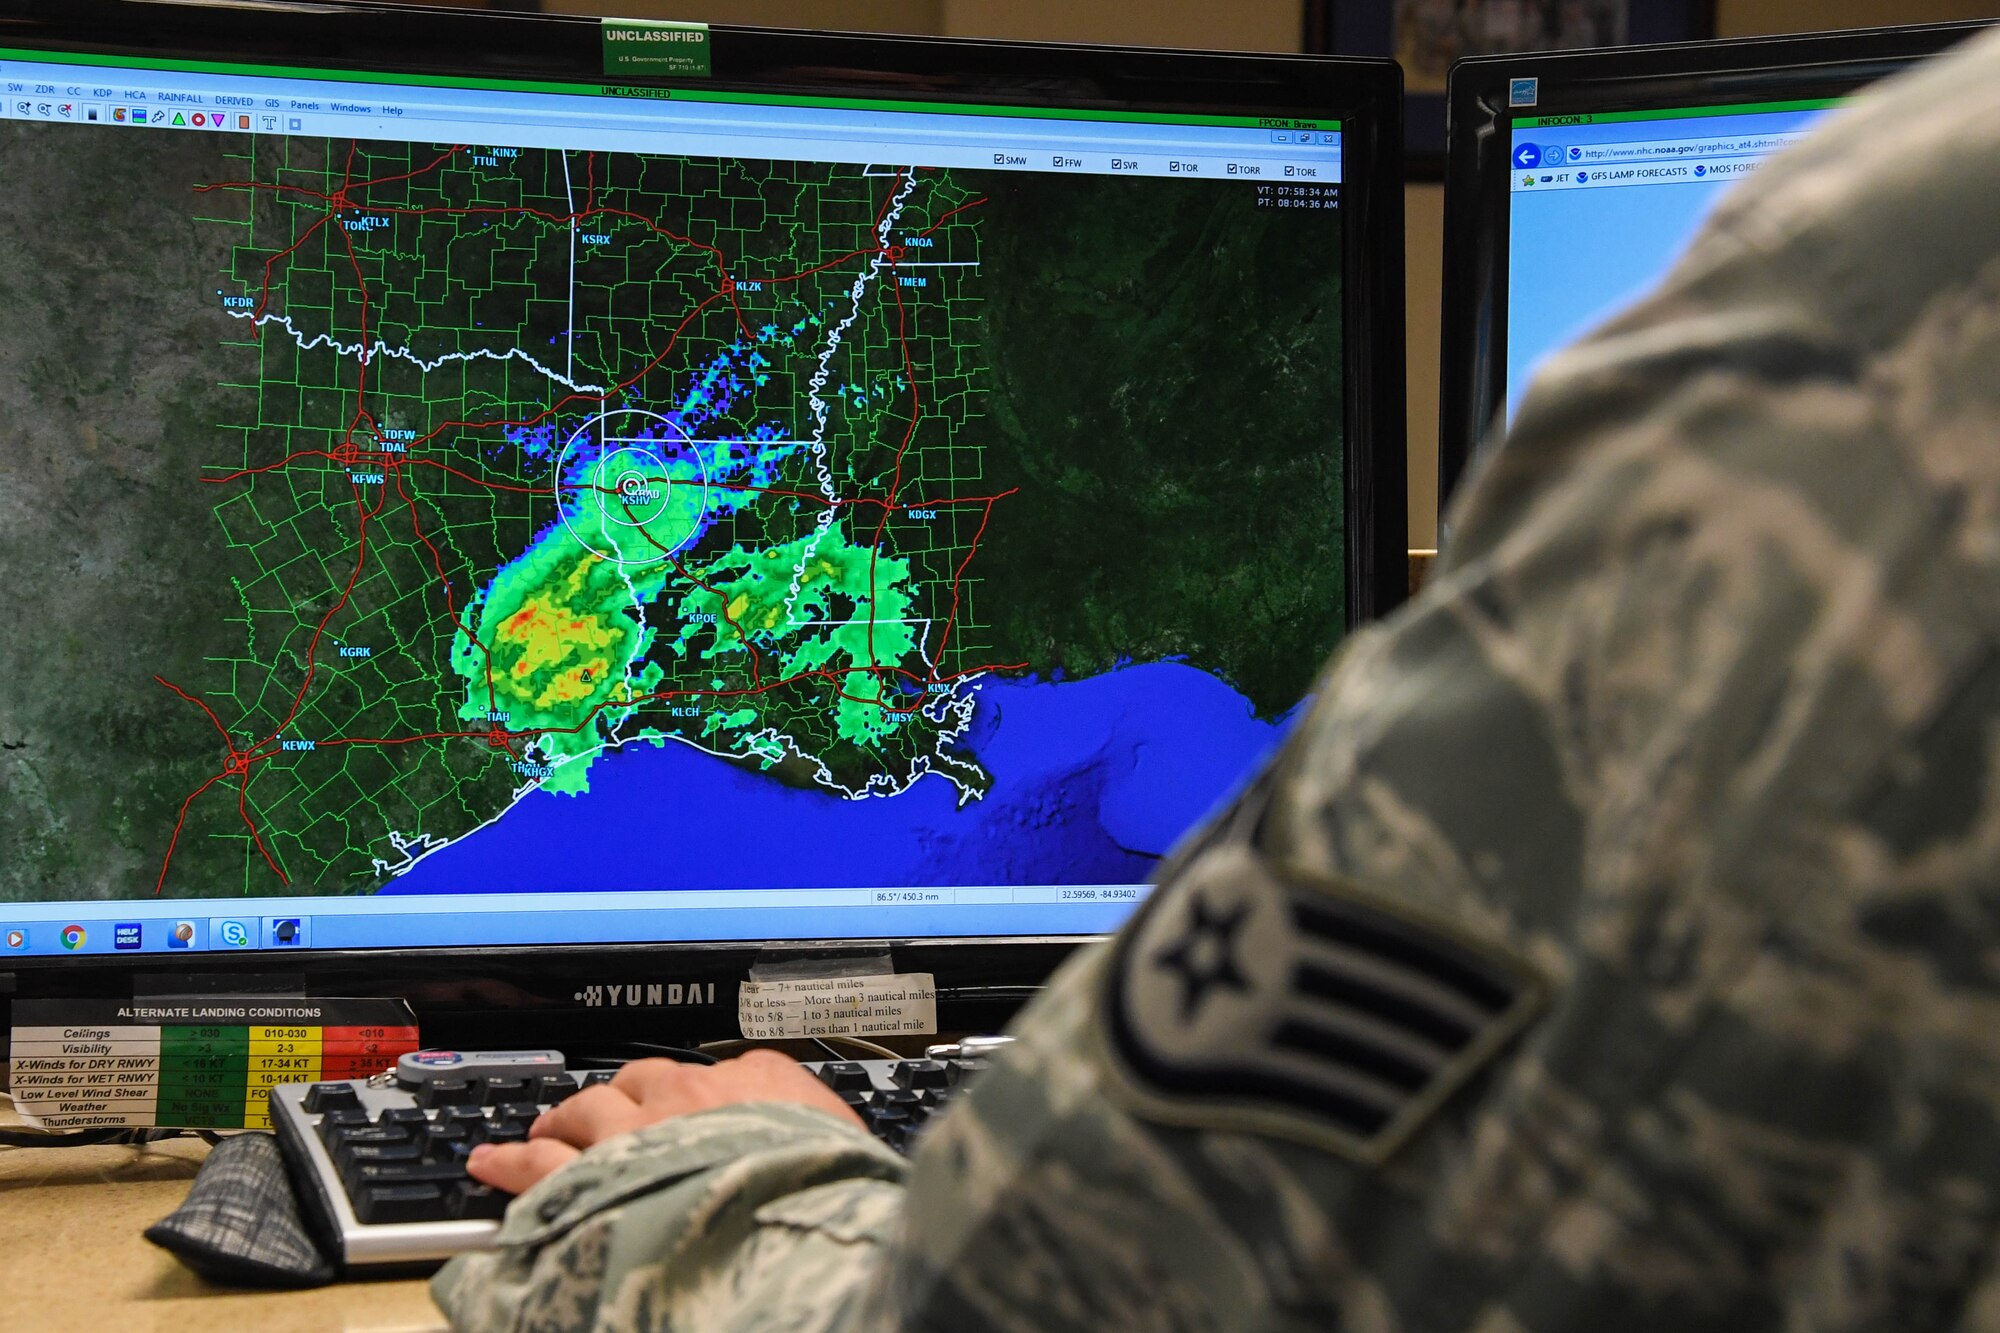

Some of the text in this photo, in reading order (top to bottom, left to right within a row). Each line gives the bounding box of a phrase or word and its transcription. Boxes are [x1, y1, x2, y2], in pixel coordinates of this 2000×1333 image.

[606, 30, 704, 42] UNCLASSIFIED
[8, 83, 23, 92] SW
[35, 84, 56, 94] ZDR
[66, 86, 81, 96] CC
[601, 86, 671, 98] UNCLASSIFIED
[93, 88, 112, 98] KDP
[124, 90, 146, 100] HCA
[158, 92, 204, 104] RAINFALL
[215, 95, 254, 106] DERIVED
[264, 98, 280, 108] GIS
[290, 100, 320, 110] Panels
[330, 102, 372, 113] Windows
[382, 106, 404, 116] Help
[1259, 118, 1318, 128] FPCON: Bravo
[1537, 115, 1592, 126] INFOCON: 3
[492, 147, 518, 158] KINX
[472, 156, 500, 166] TTUL
[1006, 156, 1027, 165] SMW
[1064, 158, 1082, 168] FFW
[1122, 160, 1138, 170] SVR
[1181, 163, 1198, 172] TOR
[1238, 166, 1260, 174] TORR
[1296, 168, 1317, 176] TORE
[1709, 162, 1763, 174] MOS FOREC
[1555, 174, 1569, 182] JET
[1591, 168, 1688, 180] GFS LAMP FORECASTS
[1257, 186, 1338, 196] VT: 07:58:34 AM
[1258, 198, 1338, 208] PT: 08:04:36 AM
[361, 216, 390, 228] KTLX
[582, 234, 610, 244] KSRX
[904, 236, 933, 248] KNQA
[736, 281, 762, 291] KLZK
[898, 277, 926, 288] TMEM
[224, 297, 254, 308] KFDR
[384, 430, 416, 440] TDFW
[380, 442, 408, 452] TDAL
[352, 474, 384, 485] KFWS
[622, 495, 650, 504] KSHV
[908, 509, 936, 520] KDGX
[689, 613, 717, 624] KPOE
[340, 646, 371, 657] KGRK
[928, 684, 950, 692] KLIX
[486, 712, 510, 722] TIAH
[672, 707, 700, 717] KLCH
[886, 713, 914, 722] TMSY
[282, 740, 316, 751] KEWX
[511, 763, 540, 773] TH
[524, 767, 554, 777] KHGX
[902, 892, 923, 901] 450.3
[1062, 889, 1136, 900] 32.59569, -84.93402
[778, 983, 792, 992] 7+
[794, 980, 834, 992] nautical
[837, 979, 864, 989] miles
[584, 983, 715, 1006] HYUNDAI
[754, 1000, 764, 1008] or
[767, 998, 786, 1007] less
[804, 996, 832, 1006] More
[834, 994, 856, 1004] than
[858, 992, 864, 1002] 3
[868, 990, 906, 1002] nautical
[909, 989, 935, 1000] miles
[117, 1008, 322, 1018] ALTERNATE LANDING CONDITIONS
[740, 1006, 902, 1022] 3/8 to 5/8 1 to 3 nautical miles
[358, 1028, 384, 1038] <010
[756, 1029, 766, 1038] to
[768, 1026, 785, 1036] 8/8
[803, 1025, 826, 1036] Less
[828, 1024, 850, 1034] than
[854, 1022, 858, 1032] 1
[862, 1020, 900, 1032] nautical
[903, 1018, 925, 1030] mile
[64, 1029, 110, 1040] Ceilings
[200, 1029, 220, 1038] 030
[264, 1029, 307, 1038] 010-030
[62, 1044, 112, 1056] Visibility
[277, 1044, 294, 1052] 2-3
[366, 1044, 378, 1052] <2
[16, 1059, 155, 1070] X-Winds for DRY RNWY
[210, 1058, 226, 1068] KT
[262, 1058, 310, 1068] 17-34 KT
[360, 1058, 373, 1068] 35
[376, 1058, 391, 1068] KT
[14, 1074, 154, 1085] X-Winds for WET RNWY
[208, 1074, 224, 1083] KT
[260, 1074, 309, 1084] 10-14 KT
[20, 1088, 148, 1100] Low Level Wind Shear
[184, 1089, 219, 1098] NONE
[251, 1090, 269, 1098] FO
[59, 1102, 108, 1112] Weather
[172, 1102, 230, 1115] No Sig Wx
[42, 1116, 126, 1127] Thunderstorms
[184, 1116, 216, 1126] VCTS
